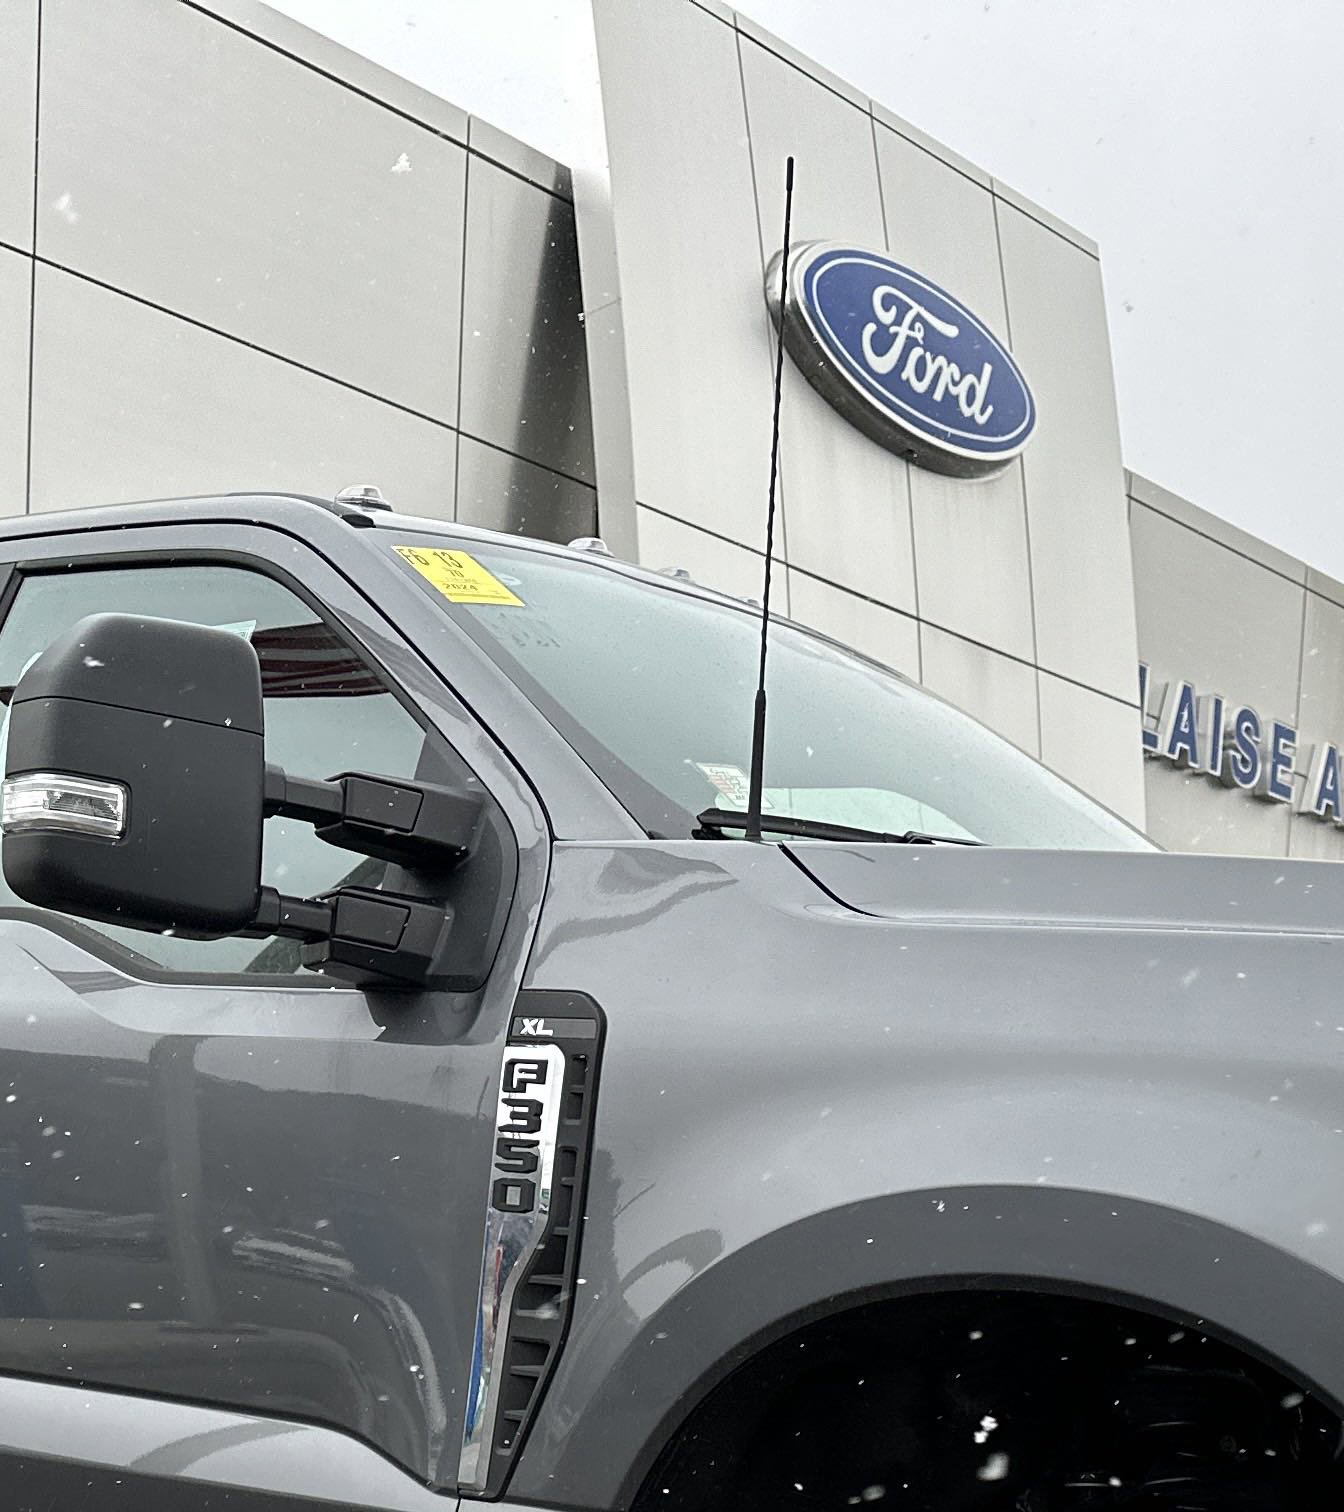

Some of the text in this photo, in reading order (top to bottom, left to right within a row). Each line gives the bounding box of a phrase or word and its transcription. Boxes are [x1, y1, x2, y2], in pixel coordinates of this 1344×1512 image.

[861, 284, 994, 425] Ford
[519, 1018, 554, 1037] XL
[492, 1058, 549, 1214] F350
